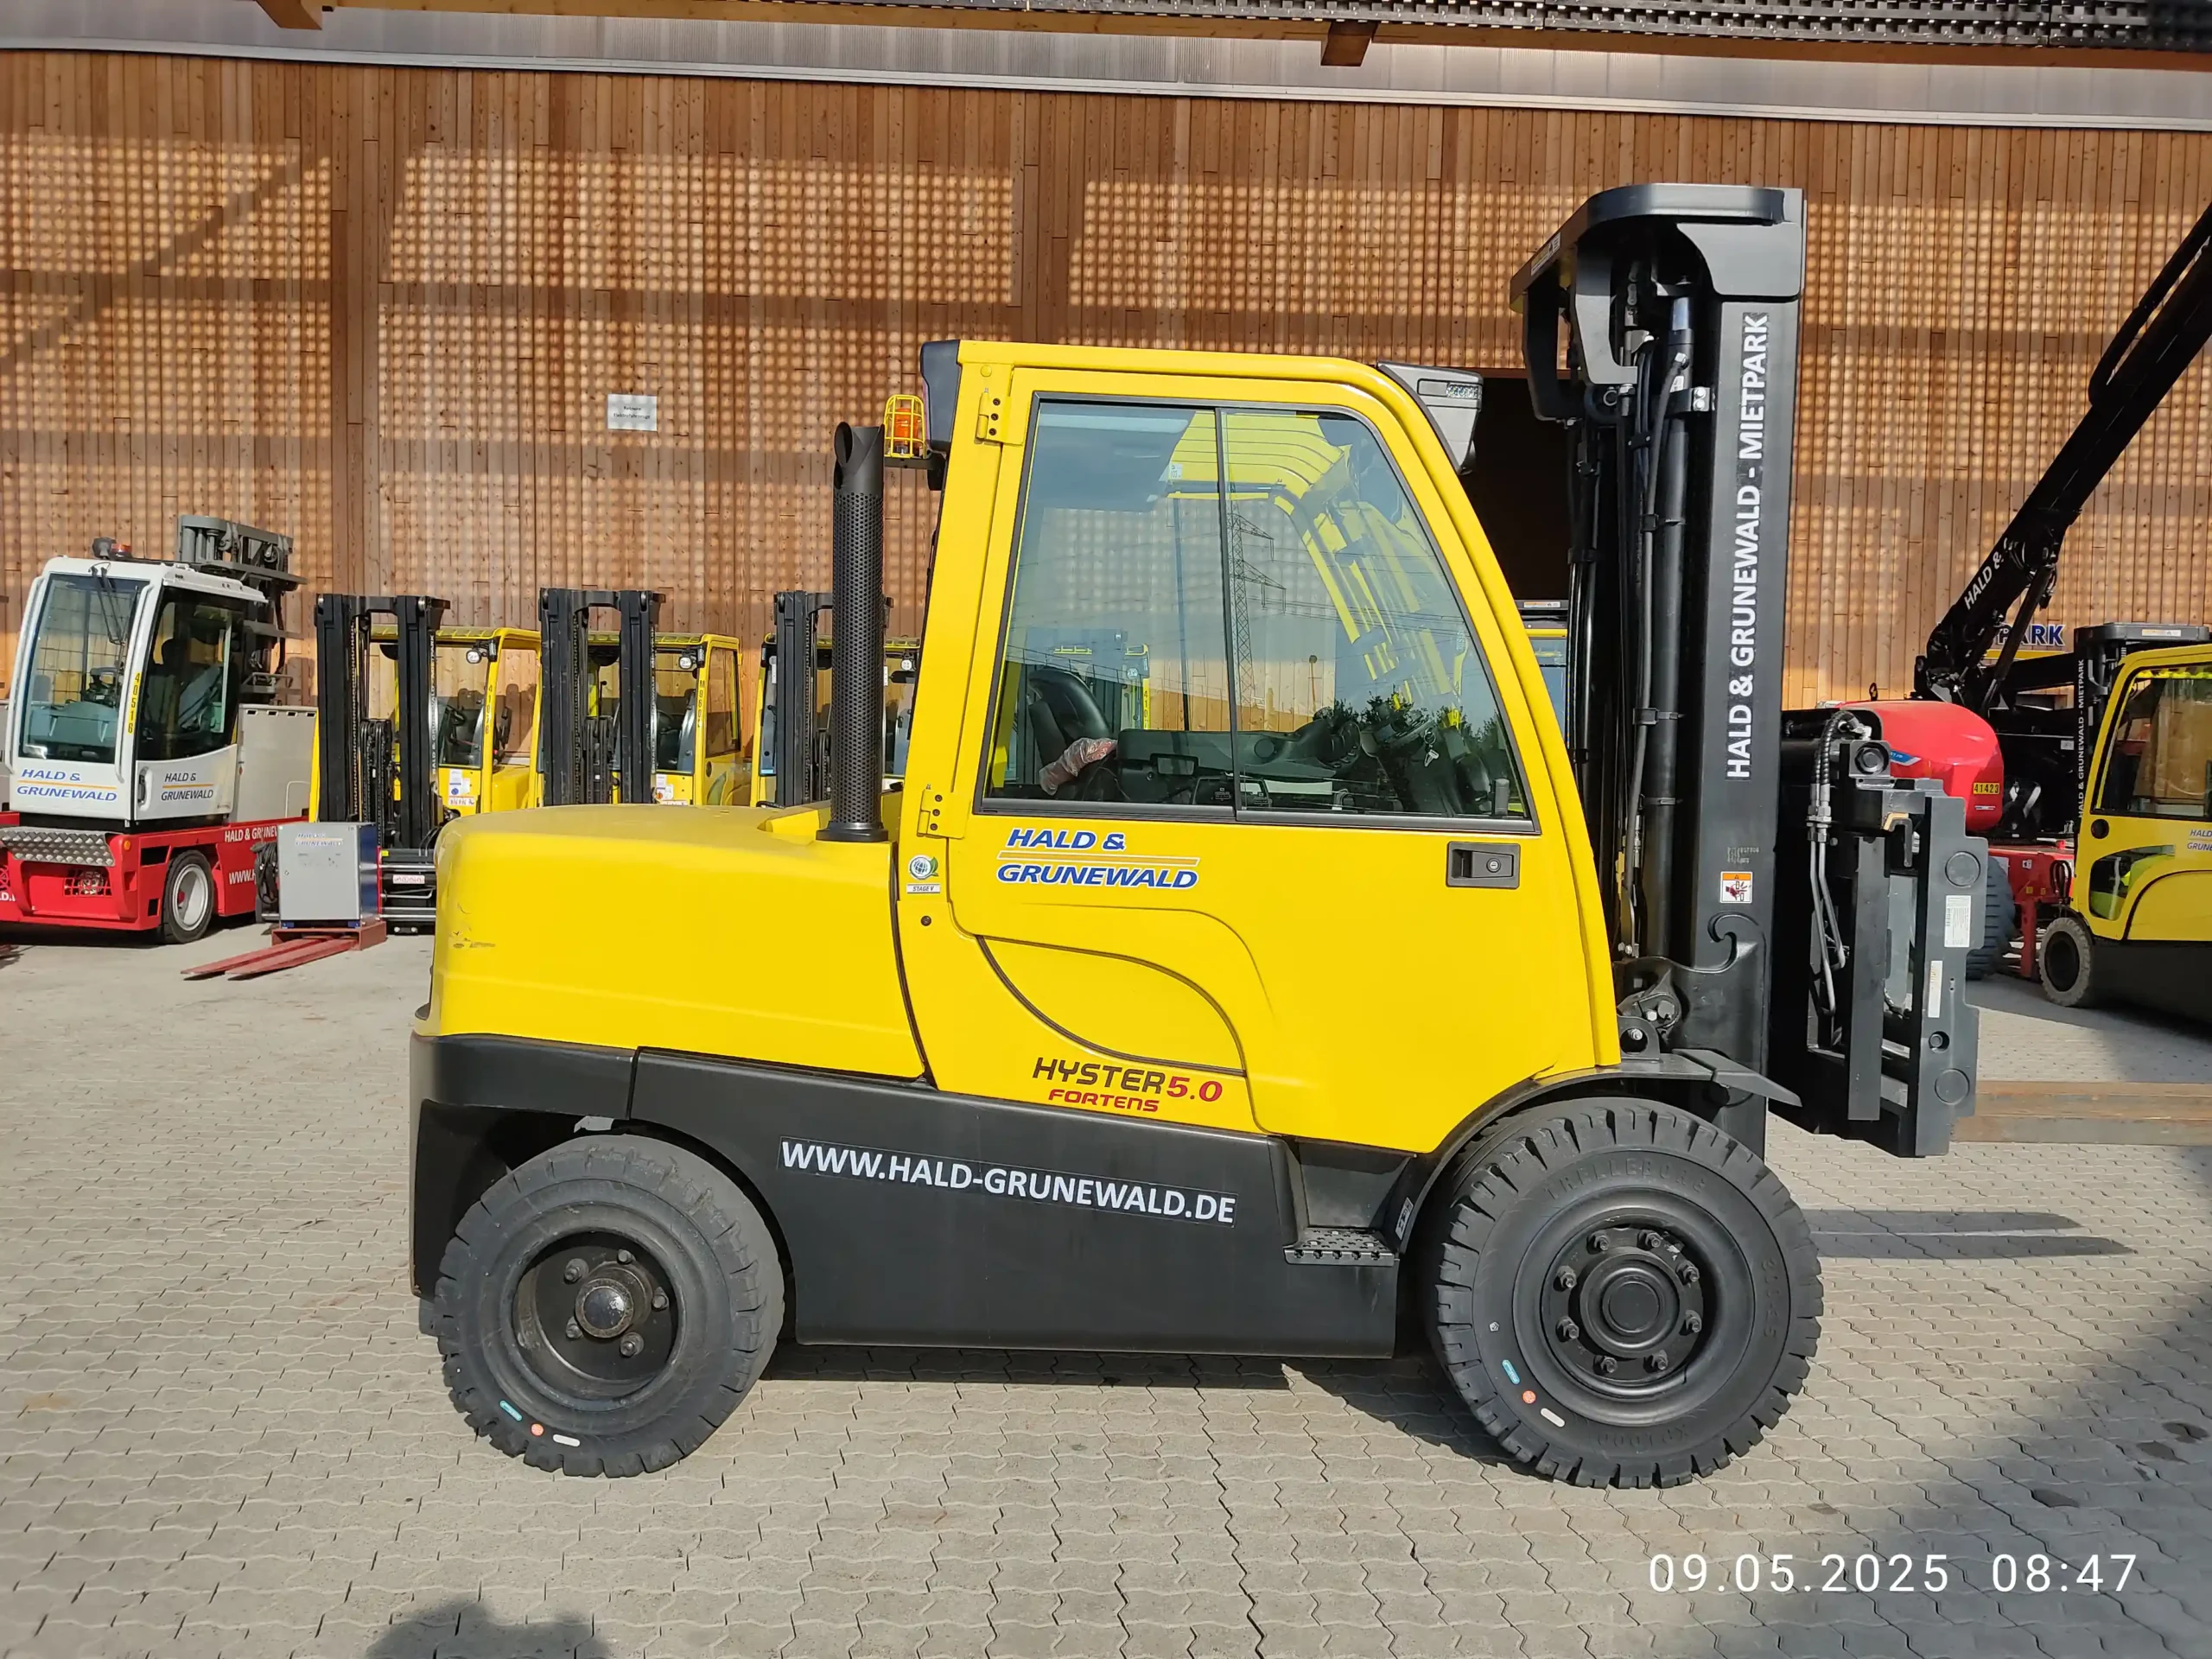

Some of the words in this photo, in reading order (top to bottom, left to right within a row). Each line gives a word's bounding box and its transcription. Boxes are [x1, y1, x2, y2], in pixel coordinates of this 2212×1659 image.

[1738, 315, 1768, 460] MIETPARK
[1748, 467, 1756, 478] -
[1730, 485, 1760, 666] GRUNEWALD
[1963, 565, 1993, 610] HALD
[1993, 551, 2005, 569] &
[1997, 623, 2066, 646] PRK
[1729, 674, 1753, 697] &
[128, 672, 141, 734] 40516
[1726, 704, 1752, 778] HALD
[21, 768, 66, 781] HALD
[70, 772, 81, 781] &
[164, 772, 188, 783] HALD
[190, 772, 196, 782] &
[2077, 781, 2084, 790] &
[16, 785, 118, 802] GRUNEWALD
[161, 789, 213, 801] GRUNEWALD
[1974, 784, 1999, 794] 41423
[225, 830, 244, 842] HALD
[245, 828, 251, 841] &
[251, 825, 277, 840] GRUNE
[1007, 829, 1096, 849] HALD
[1103, 833, 1126, 850] &
[997, 864, 1198, 889] GRUNEWALD
[1033, 1057, 1166, 1095] HYSTER
[1166, 1076, 1224, 1103] 5.0
[1048, 1089, 1160, 1113] FORTENS
[782, 1141, 1237, 1224] WWW.HALD-GRUNEWALD.DE
